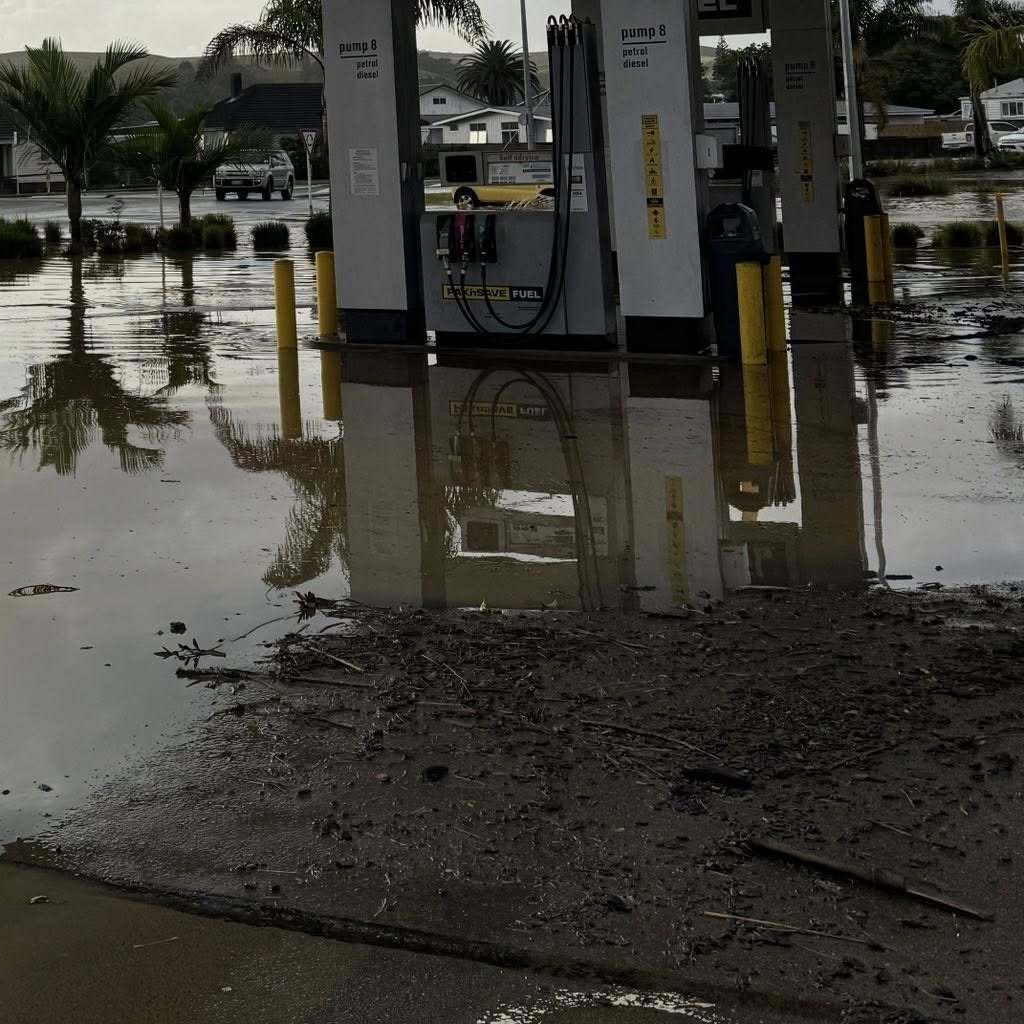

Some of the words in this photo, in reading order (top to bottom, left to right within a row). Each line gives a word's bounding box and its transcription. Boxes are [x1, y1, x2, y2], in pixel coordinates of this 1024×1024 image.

[621, 27, 656, 41] pump
[659, 24, 666, 36] 8
[339, 42, 368, 55] pump
[371, 39, 377, 50] 8
[623, 46, 648, 58] petrol
[357, 59, 378, 70] petrol
[624, 58, 649, 68] diesel
[357, 70, 379, 79] diesel
[513, 290, 541, 299] FUEL
